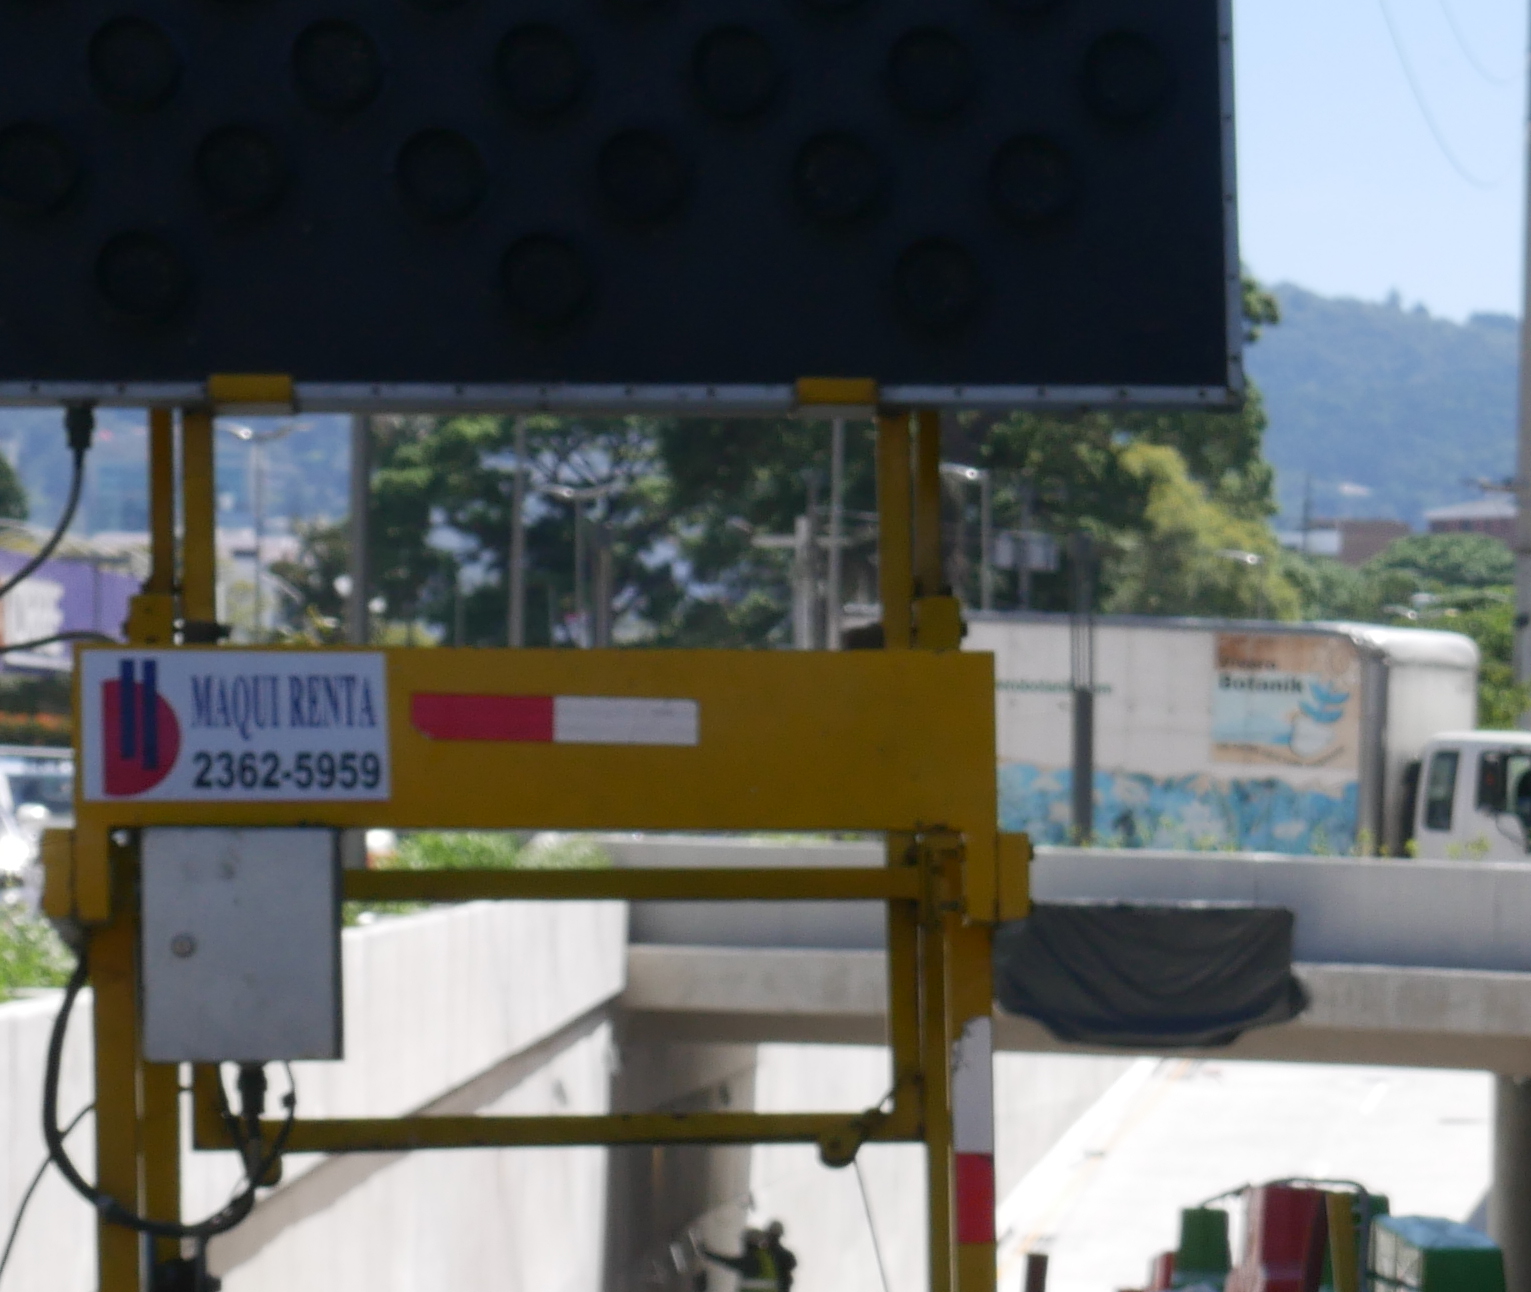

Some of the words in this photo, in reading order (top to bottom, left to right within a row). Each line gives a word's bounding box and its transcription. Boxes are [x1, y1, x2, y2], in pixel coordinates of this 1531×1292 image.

[191, 674, 281, 741] MAQUI
[288, 674, 378, 728] RENTA
[193, 751, 381, 789] 2362-5959
